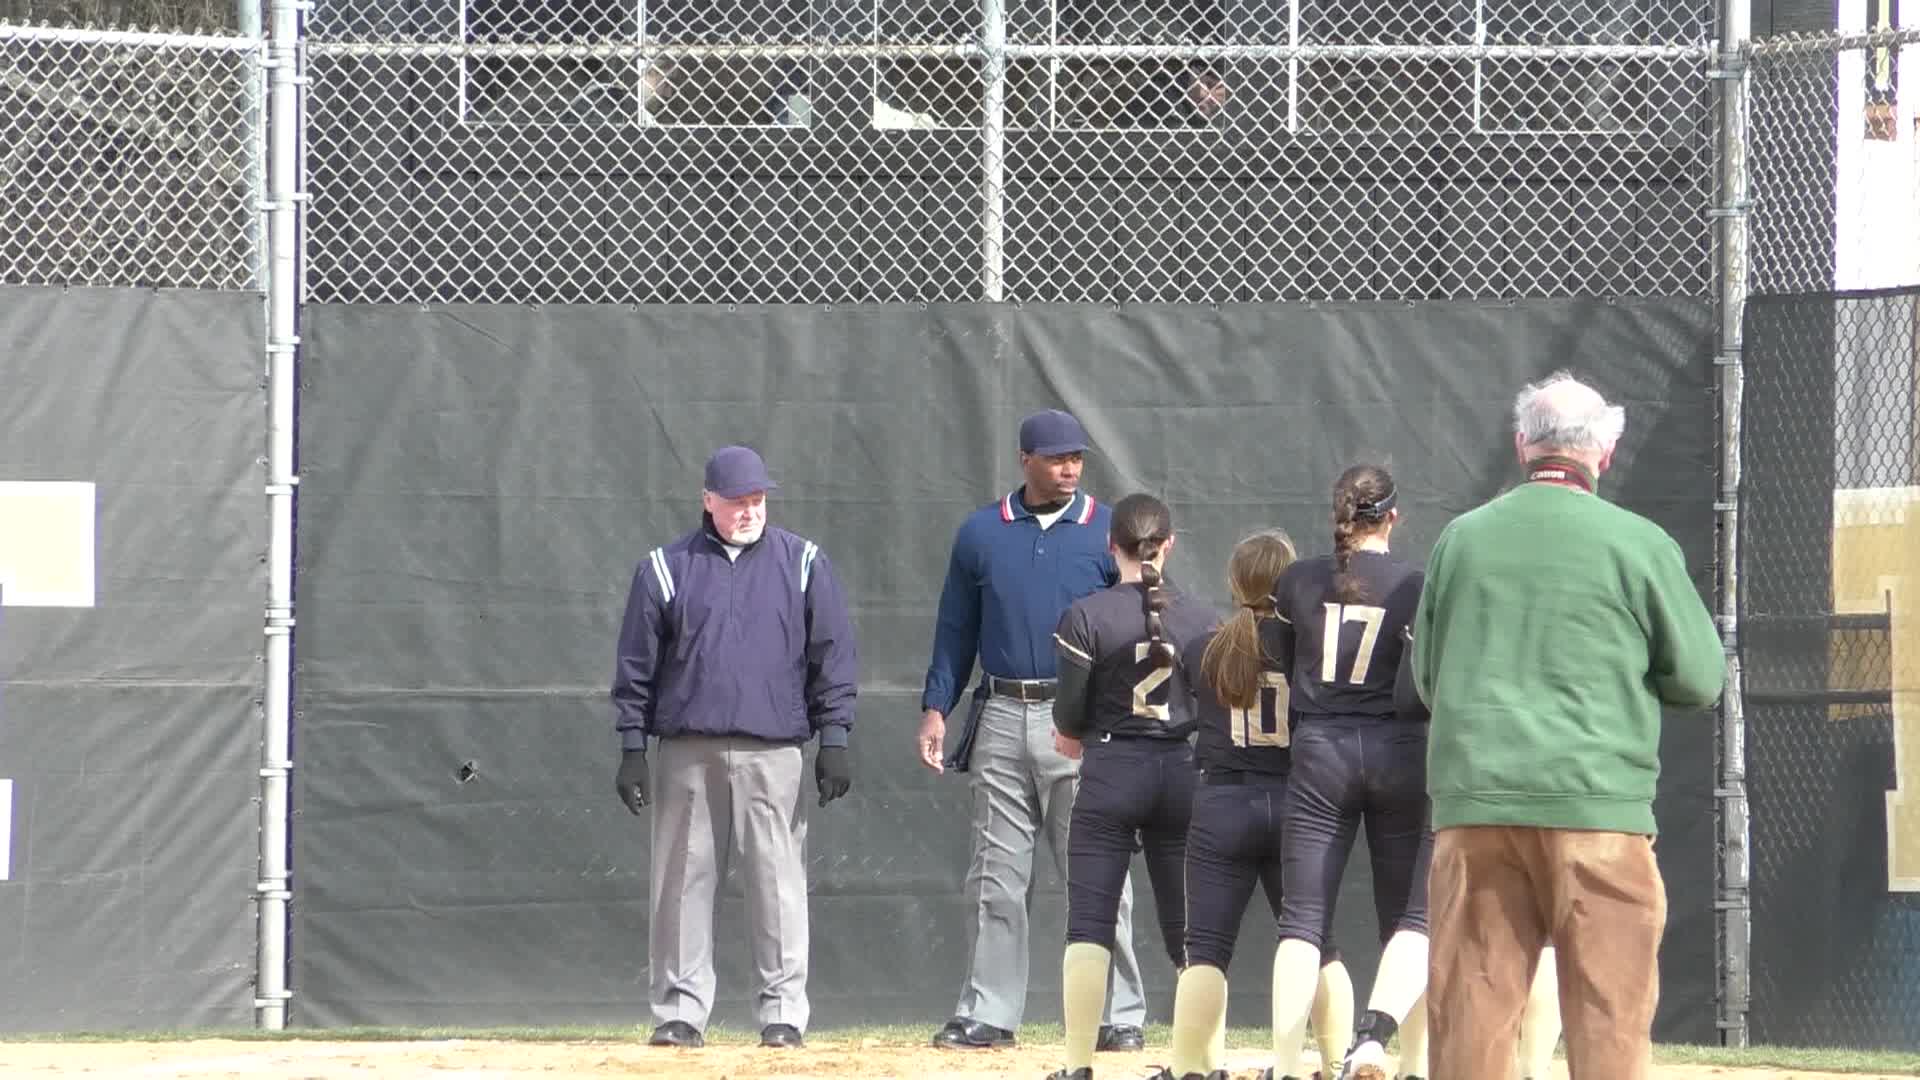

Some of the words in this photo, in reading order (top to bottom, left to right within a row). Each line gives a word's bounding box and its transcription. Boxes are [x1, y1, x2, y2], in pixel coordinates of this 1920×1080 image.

[1530, 470, 1566, 480] Canon
[1132, 642, 1175, 721] 2
[1322, 602, 1386, 684] 17
